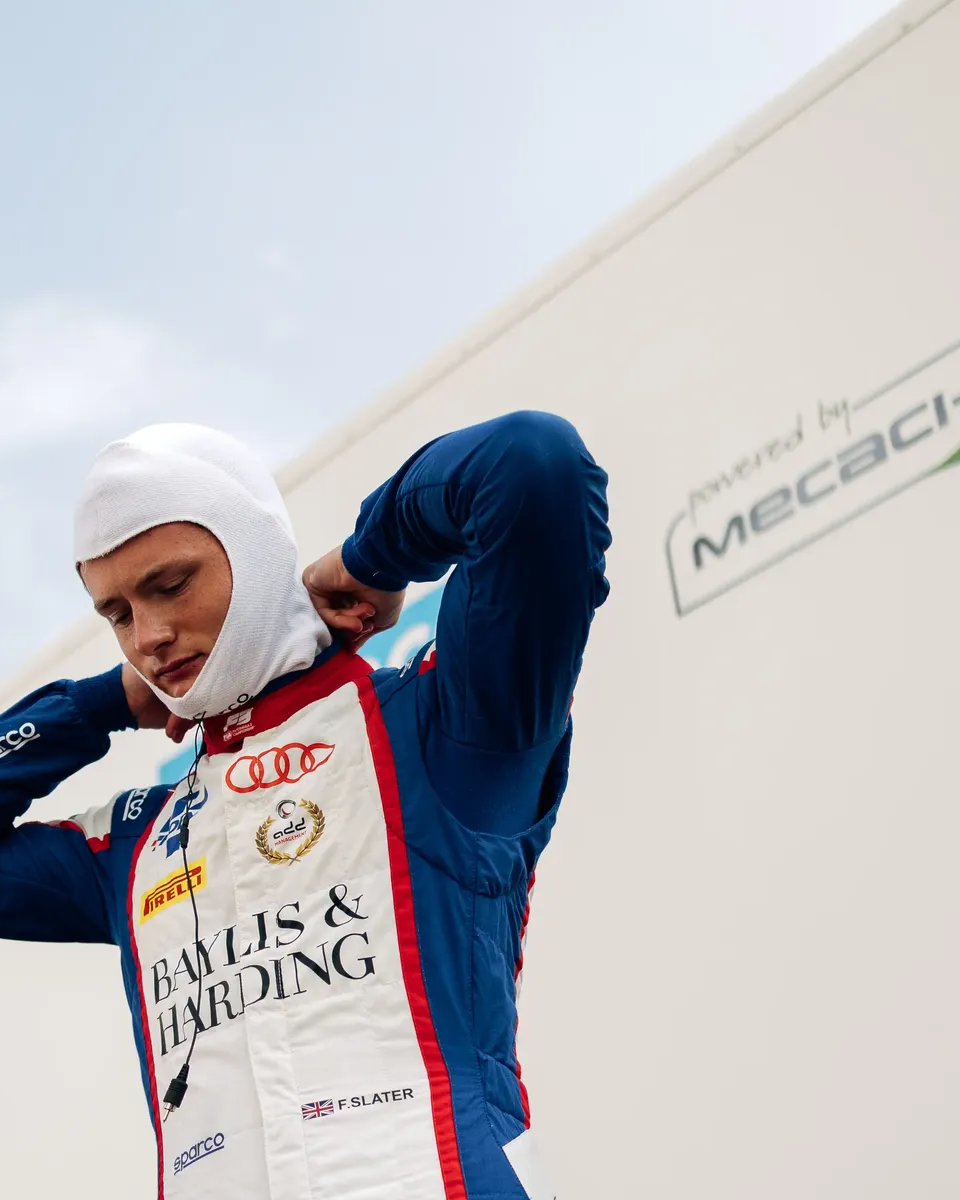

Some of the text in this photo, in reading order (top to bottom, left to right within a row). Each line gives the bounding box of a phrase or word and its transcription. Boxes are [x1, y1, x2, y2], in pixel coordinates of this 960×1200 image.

[272, 817, 307, 840] add
[274, 831, 307, 847] MANAGEMENT
[143, 865, 202, 917] PIRELLI
[150, 883, 369, 1005] BAYLIS &
[156, 931, 377, 1057] HARDING
[337, 1087, 415, 1111] F.SLATER
[173, 1131, 225, 1175] sparco
